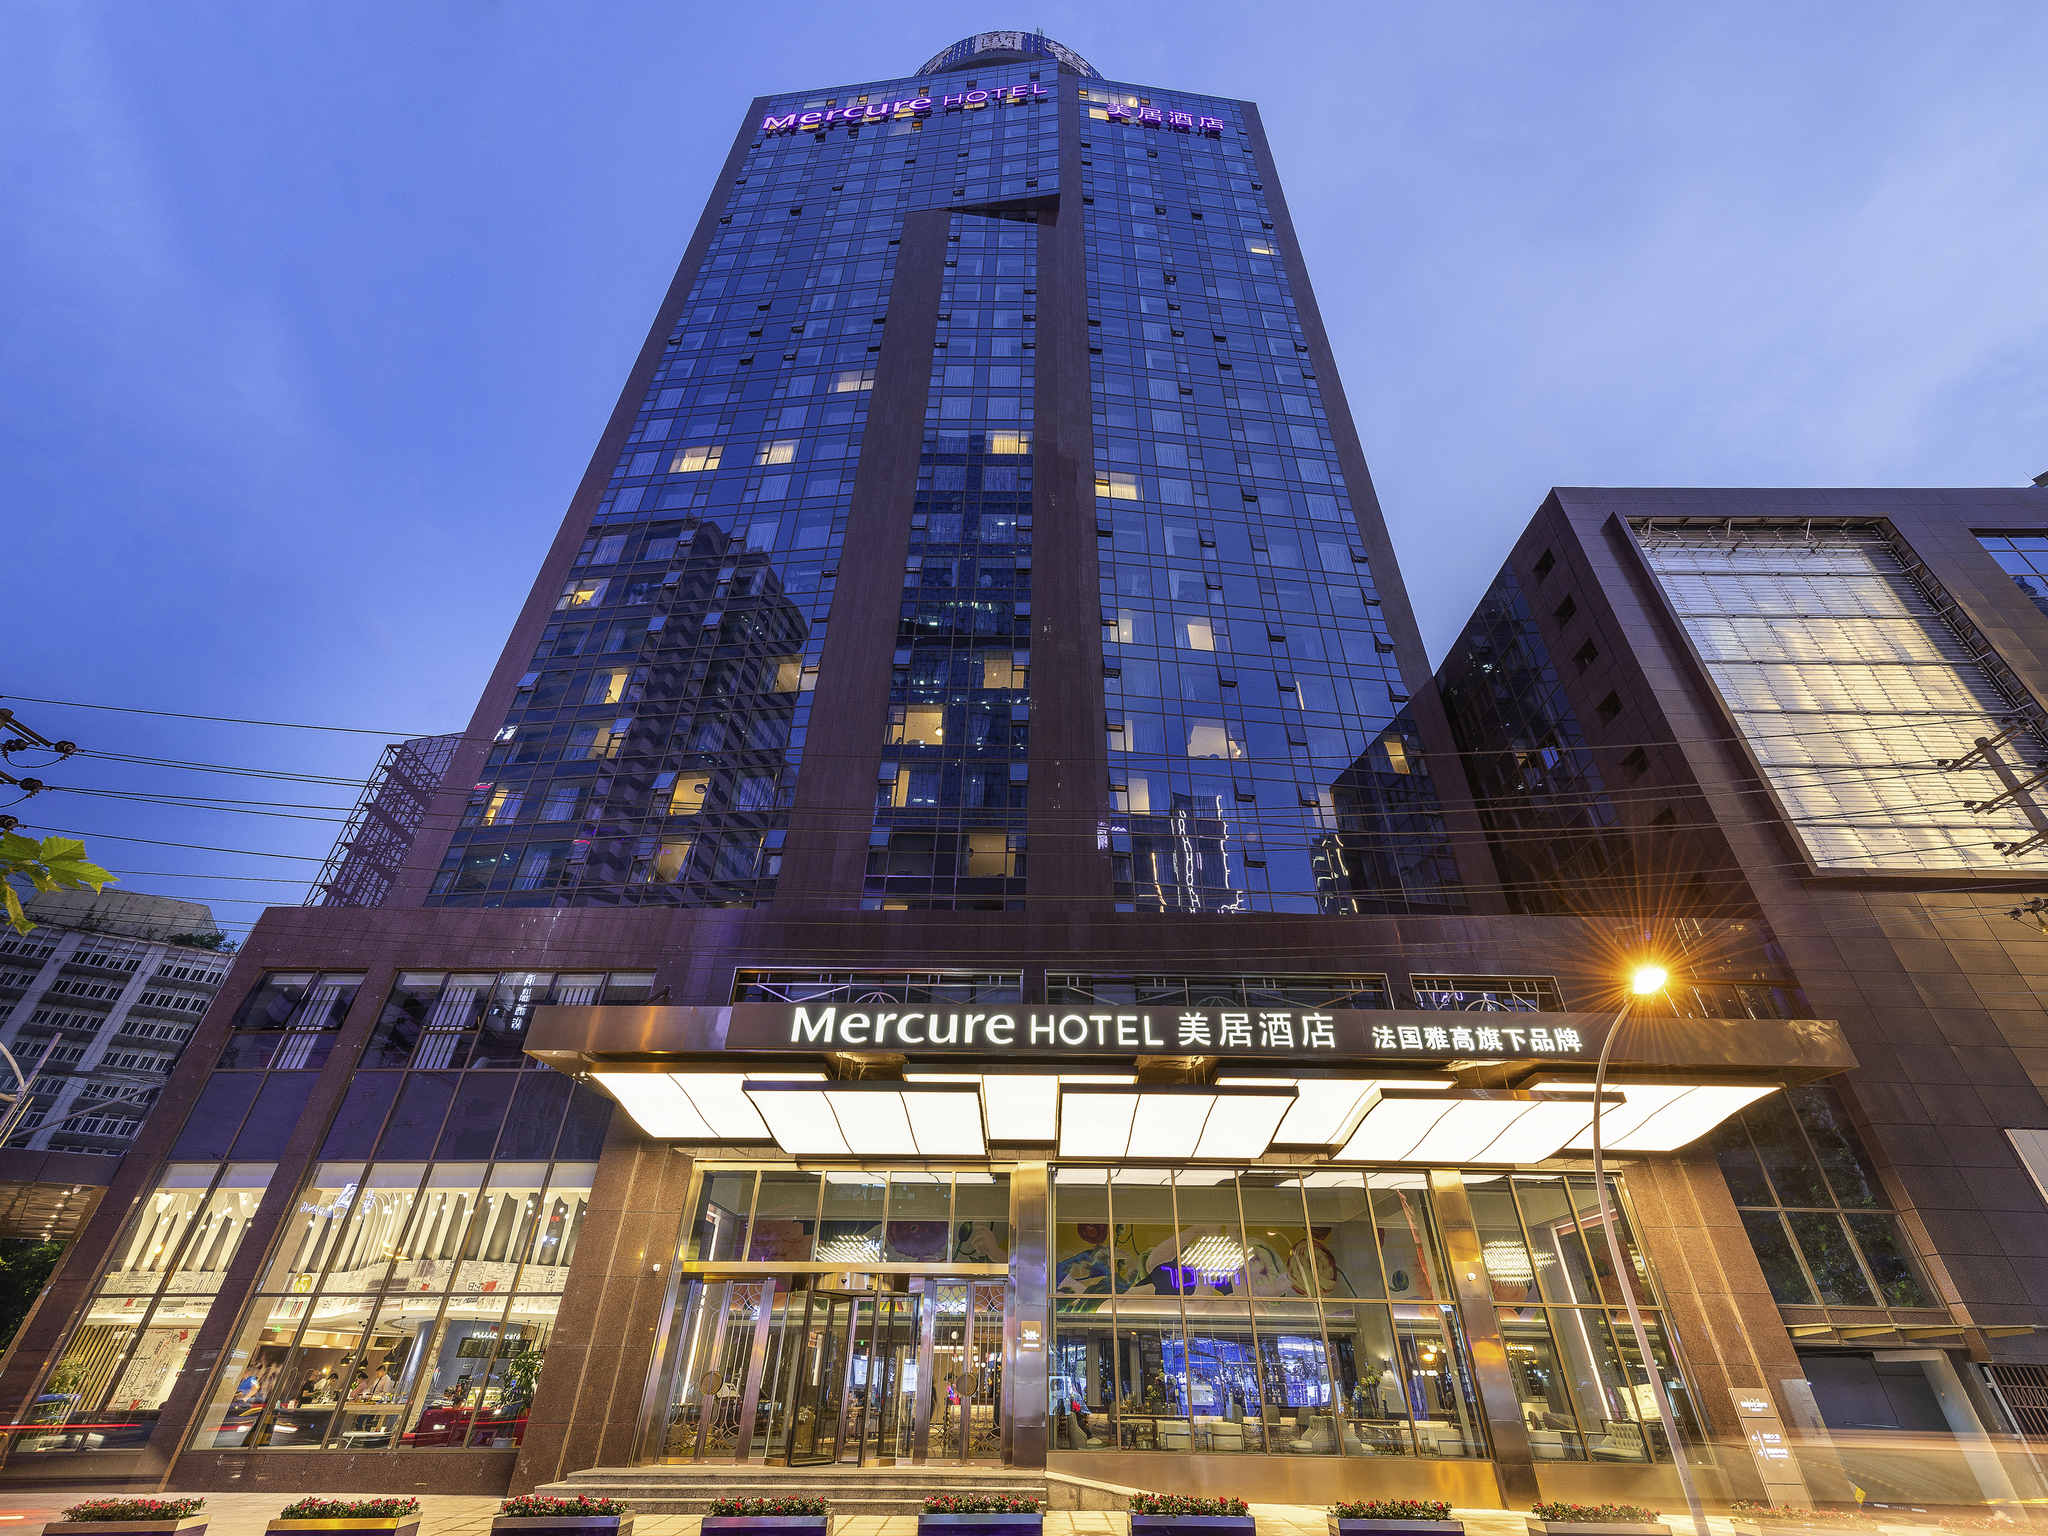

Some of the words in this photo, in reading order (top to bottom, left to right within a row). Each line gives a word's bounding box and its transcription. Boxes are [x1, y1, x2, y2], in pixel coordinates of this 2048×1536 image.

[762, 96, 932, 130] Mercure
[943, 82, 1048, 106] HOTEL
[1106, 104, 1225, 130] 美居酒店
[790, 1007, 1015, 1045] Mercure
[1030, 1014, 1165, 1046] HOTEL
[1177, 1012, 1337, 1048] 美居酒店
[1371, 1025, 1584, 1054] 法国雅高旗下品牌
